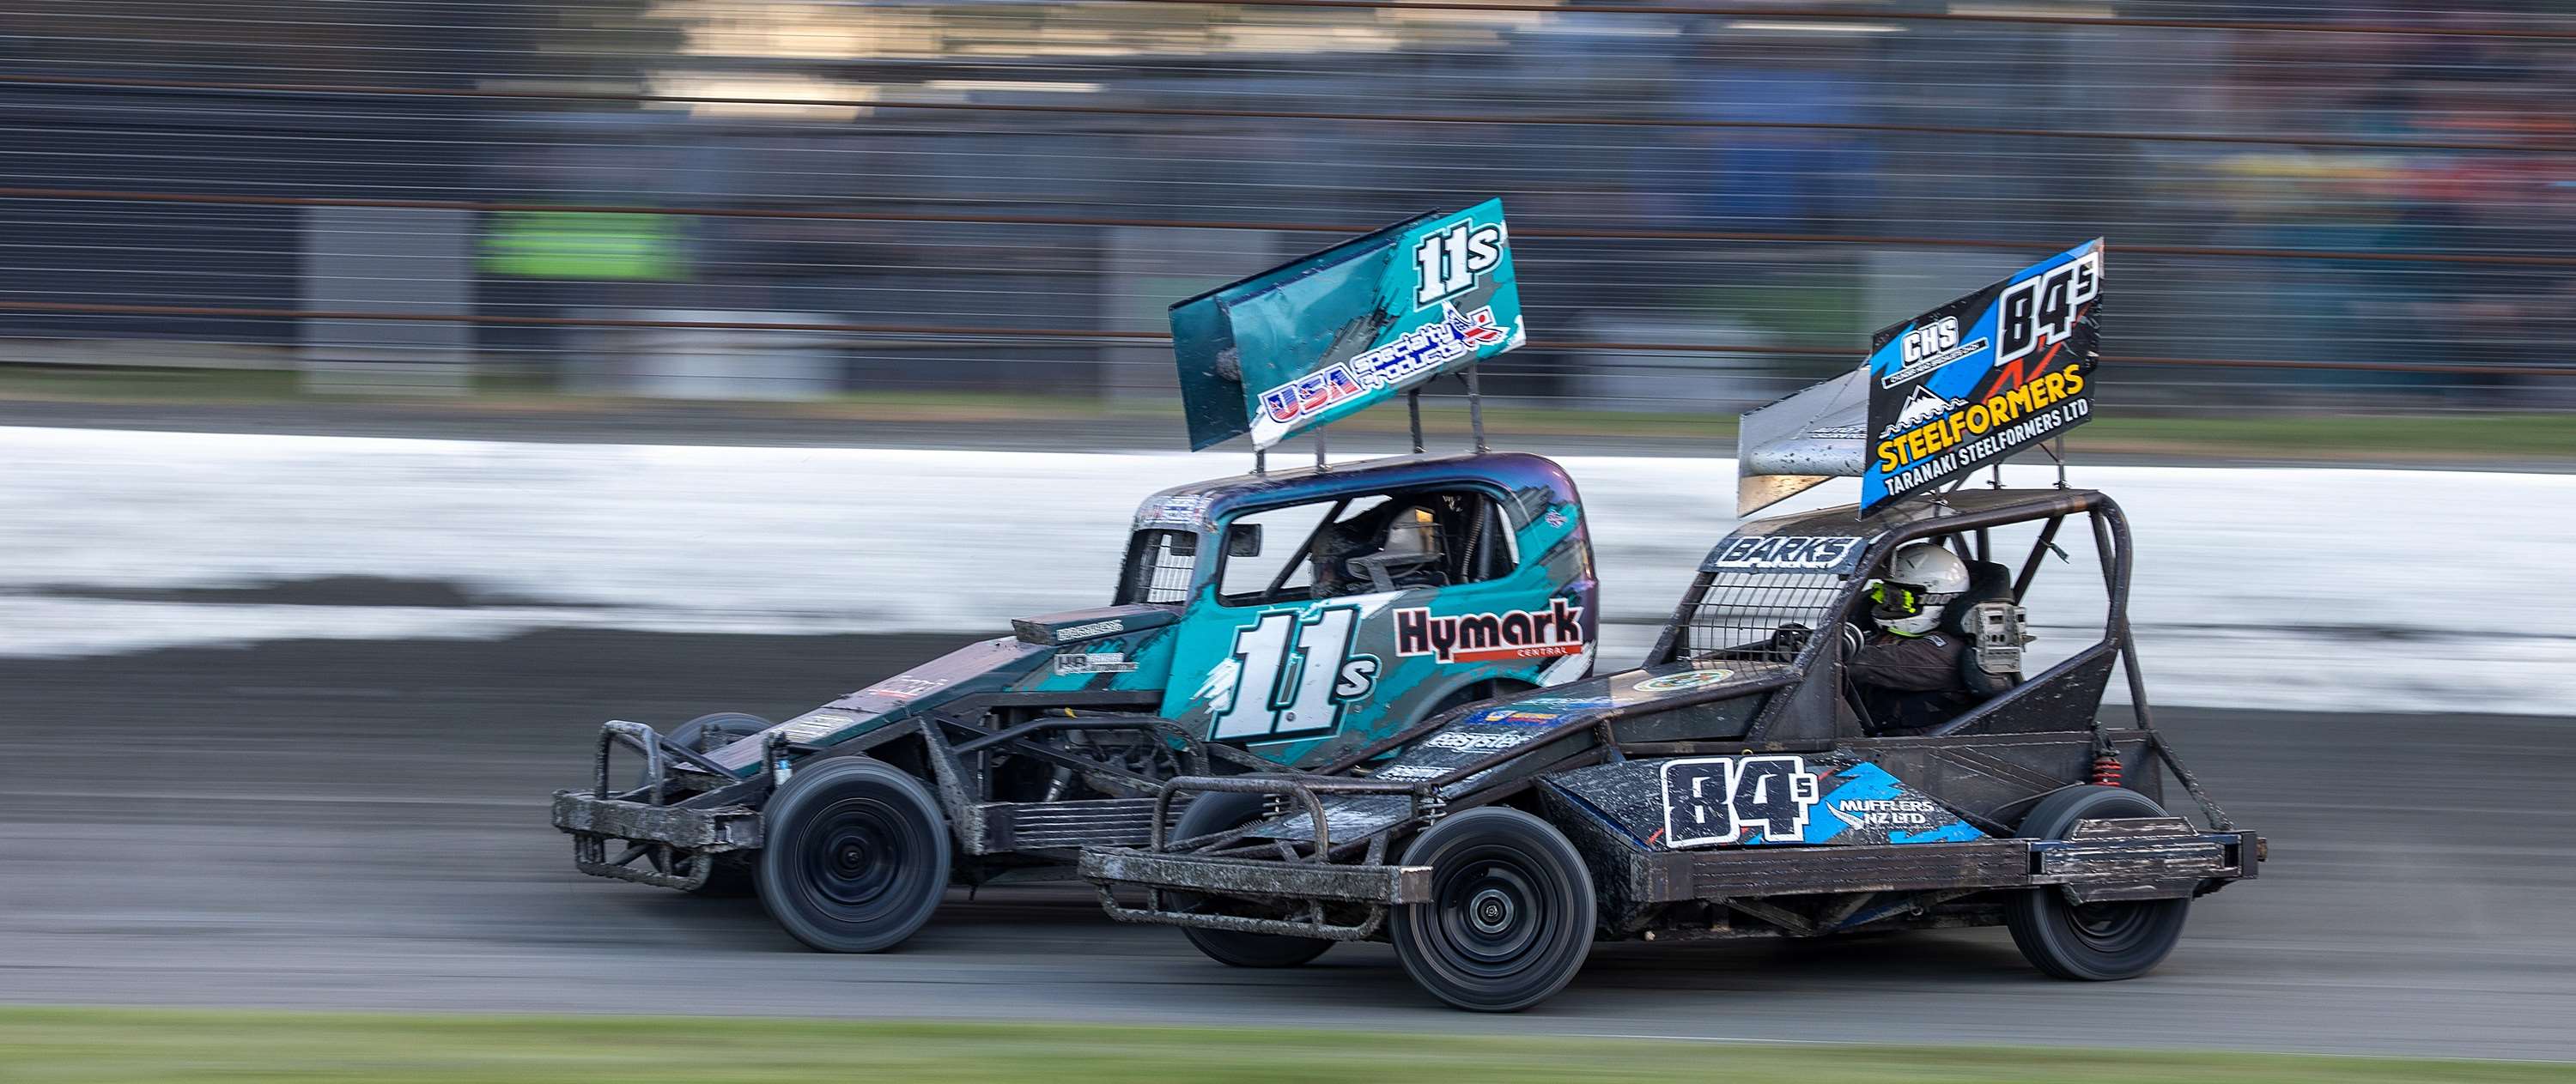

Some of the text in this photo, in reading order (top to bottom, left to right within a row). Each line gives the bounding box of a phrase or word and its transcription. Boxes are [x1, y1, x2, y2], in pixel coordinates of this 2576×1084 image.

[1352, 322, 1455, 375] specialty
[1901, 317, 1958, 367] CHS
[1262, 362, 1365, 423] USA
[1877, 364, 2085, 473] STEELFORMERS
[1885, 398, 2089, 496] TARANAKI STEELFORMERS LTD
[1716, 536, 1862, 568] BARKS
[1394, 599, 1583, 663] Hymark
[1516, 646, 1569, 657] CENTRAL
[1839, 799, 1935, 812] MUFFLERS
[1863, 812, 1926, 824] NZ LTD
